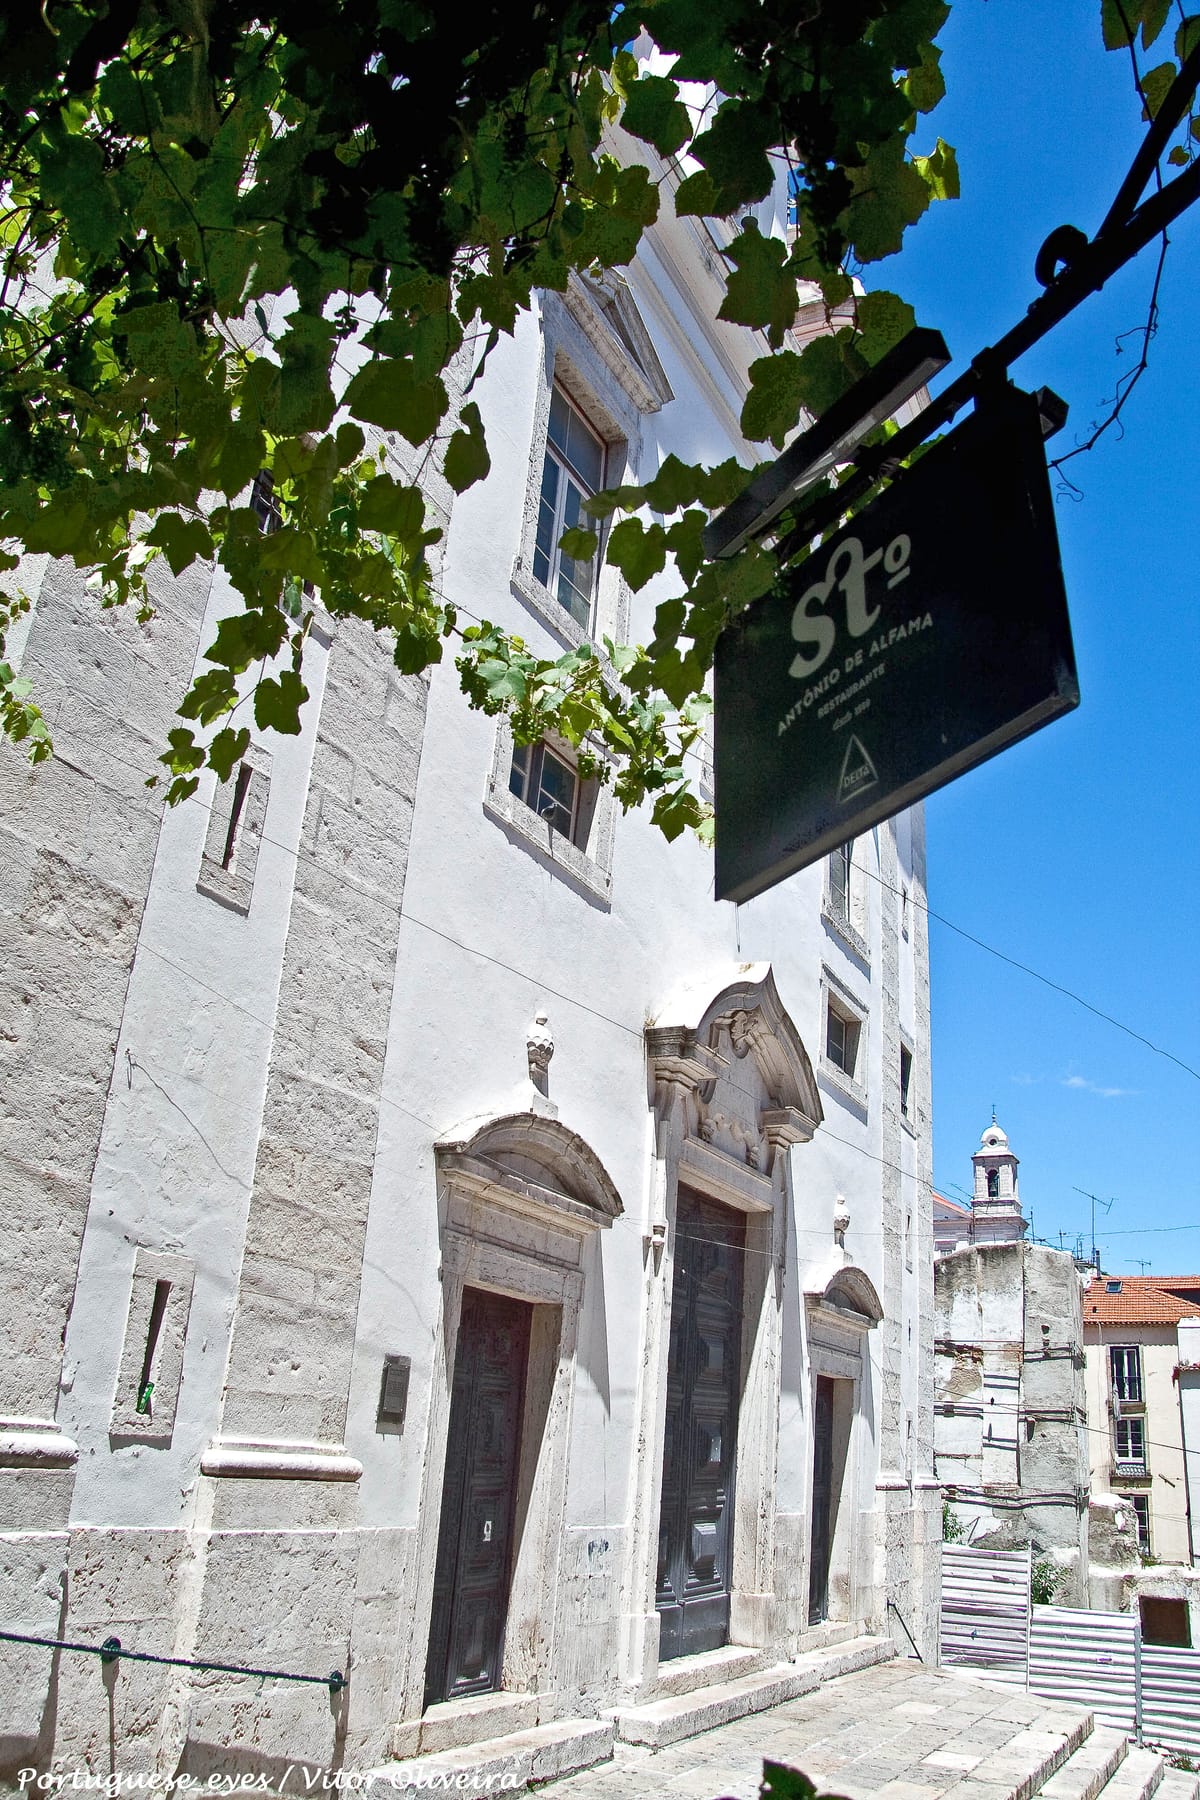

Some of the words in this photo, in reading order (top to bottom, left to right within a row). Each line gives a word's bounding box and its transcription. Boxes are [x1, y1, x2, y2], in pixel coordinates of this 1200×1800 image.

[777, 668, 841, 737] ANTÓNIO
[844, 649, 864, 673] DE
[869, 612, 934, 657] ALFAMA
[817, 662, 886, 719] RESTAURANTE
[844, 763, 870, 788] DELTA
